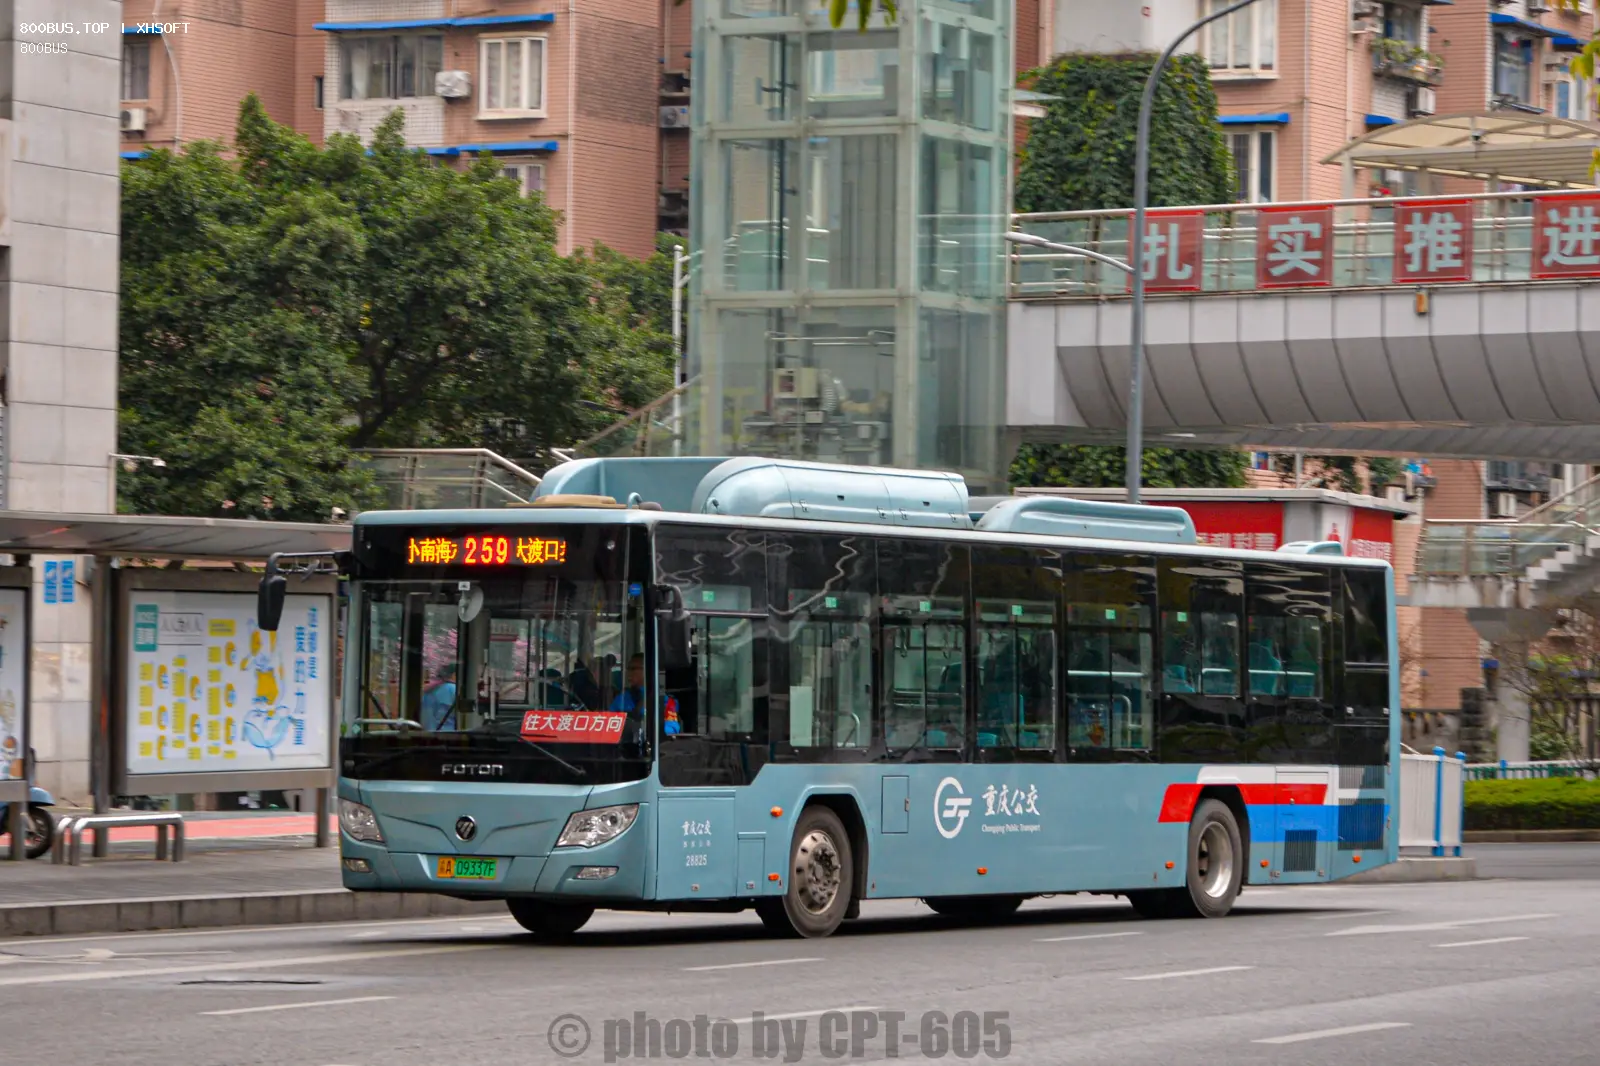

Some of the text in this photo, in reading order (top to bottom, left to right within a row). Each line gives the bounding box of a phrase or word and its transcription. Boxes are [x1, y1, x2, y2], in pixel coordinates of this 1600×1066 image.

[464, 536, 509, 564] 259
[516, 537, 567, 564] 大渡口
[524, 713, 624, 733] 往大渡口方向
[441, 763, 504, 776] FOTON
[981, 783, 1041, 817] 重庆公交
[685, 854, 708, 867] 28825
